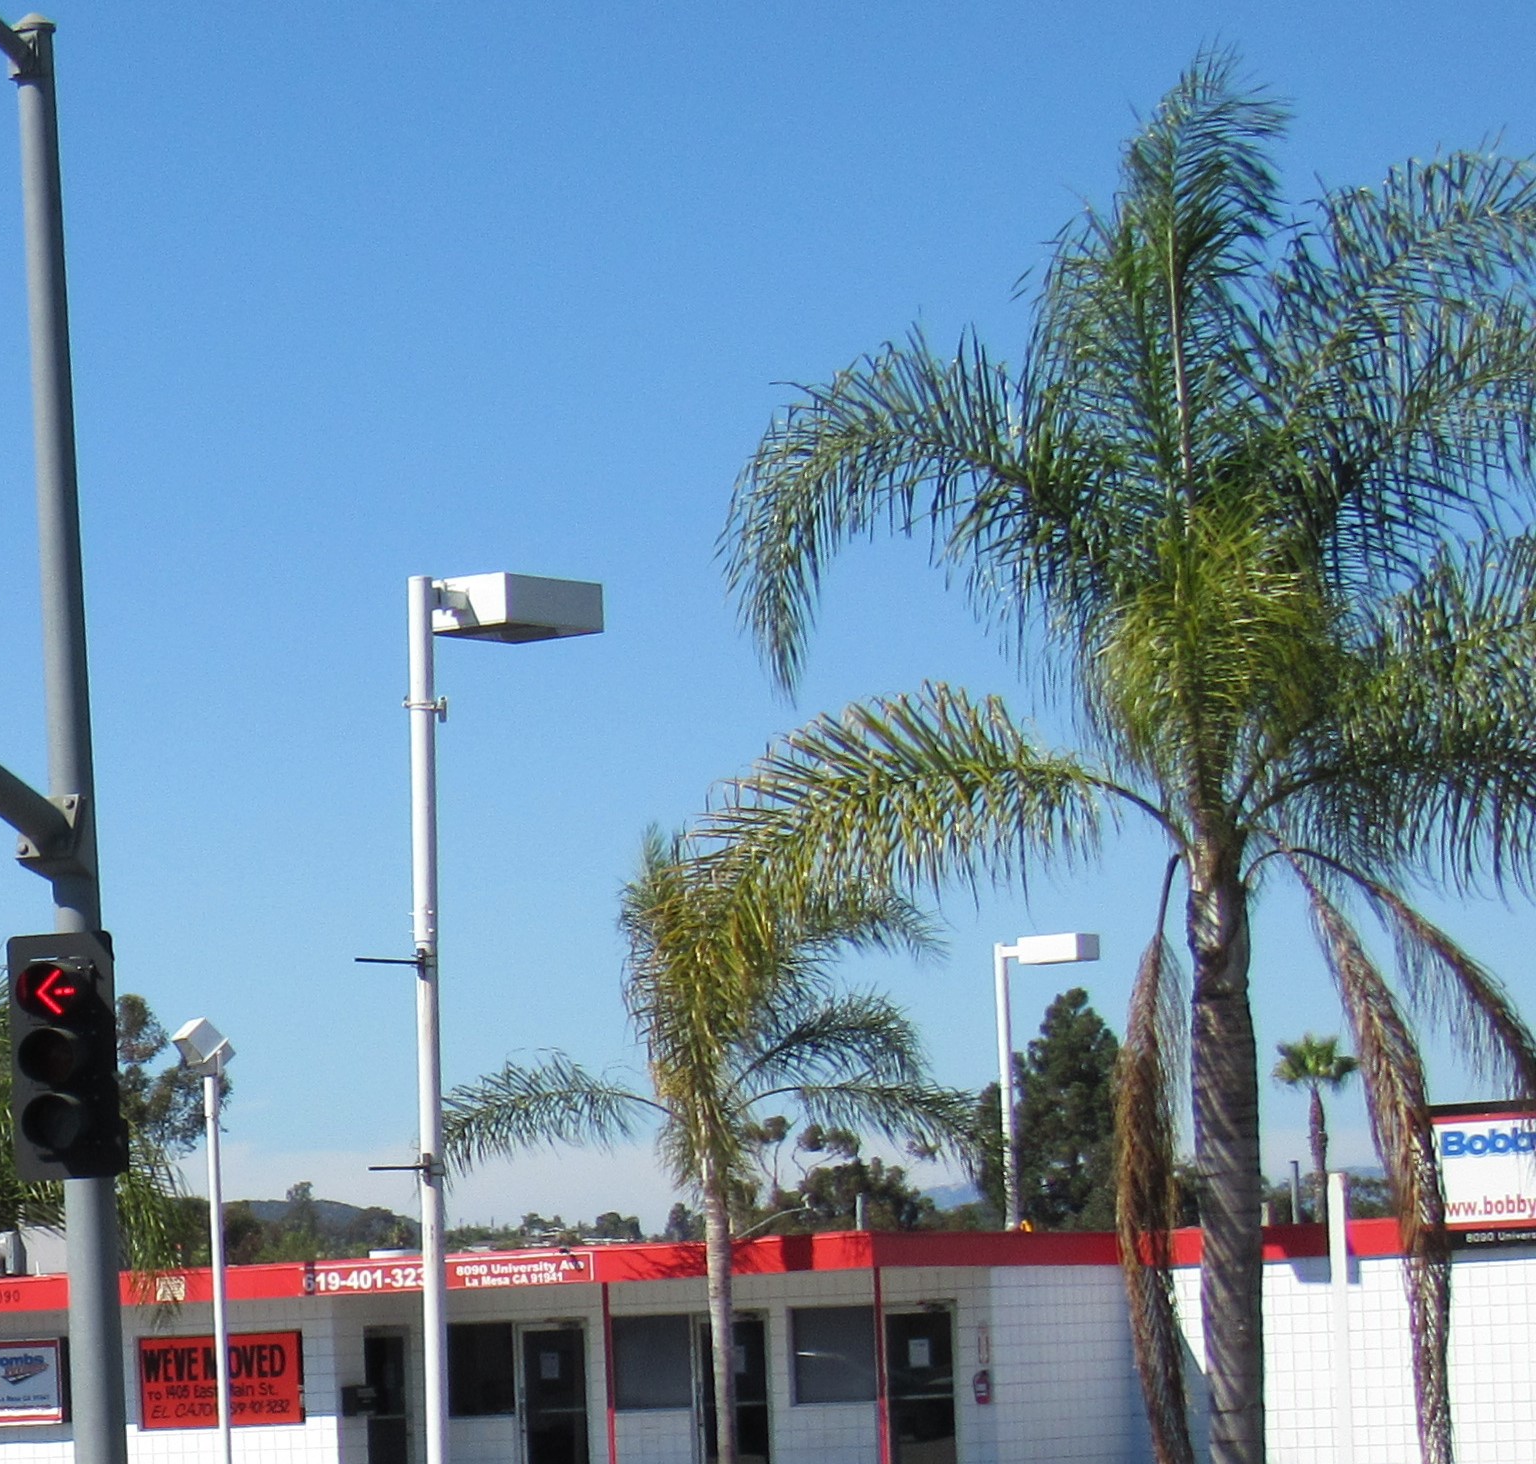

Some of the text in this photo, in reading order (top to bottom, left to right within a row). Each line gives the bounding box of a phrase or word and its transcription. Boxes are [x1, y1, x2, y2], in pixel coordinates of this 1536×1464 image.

[1441, 1128, 1536, 1156] Bobb
[1465, 1232, 1495, 1243] 8090
[455, 1264, 486, 1277] 8090
[491, 1260, 556, 1275] University
[303, 1268, 426, 1292] 619-401-323
[464, 1276, 479, 1287] La
[480, 1274, 510, 1286] Mesa
[512, 1273, 529, 1285] CA
[193, 1384, 219, 1399] Eas
[151, 1405, 170, 1419] EL
[175, 1402, 219, 1418] CAJO
